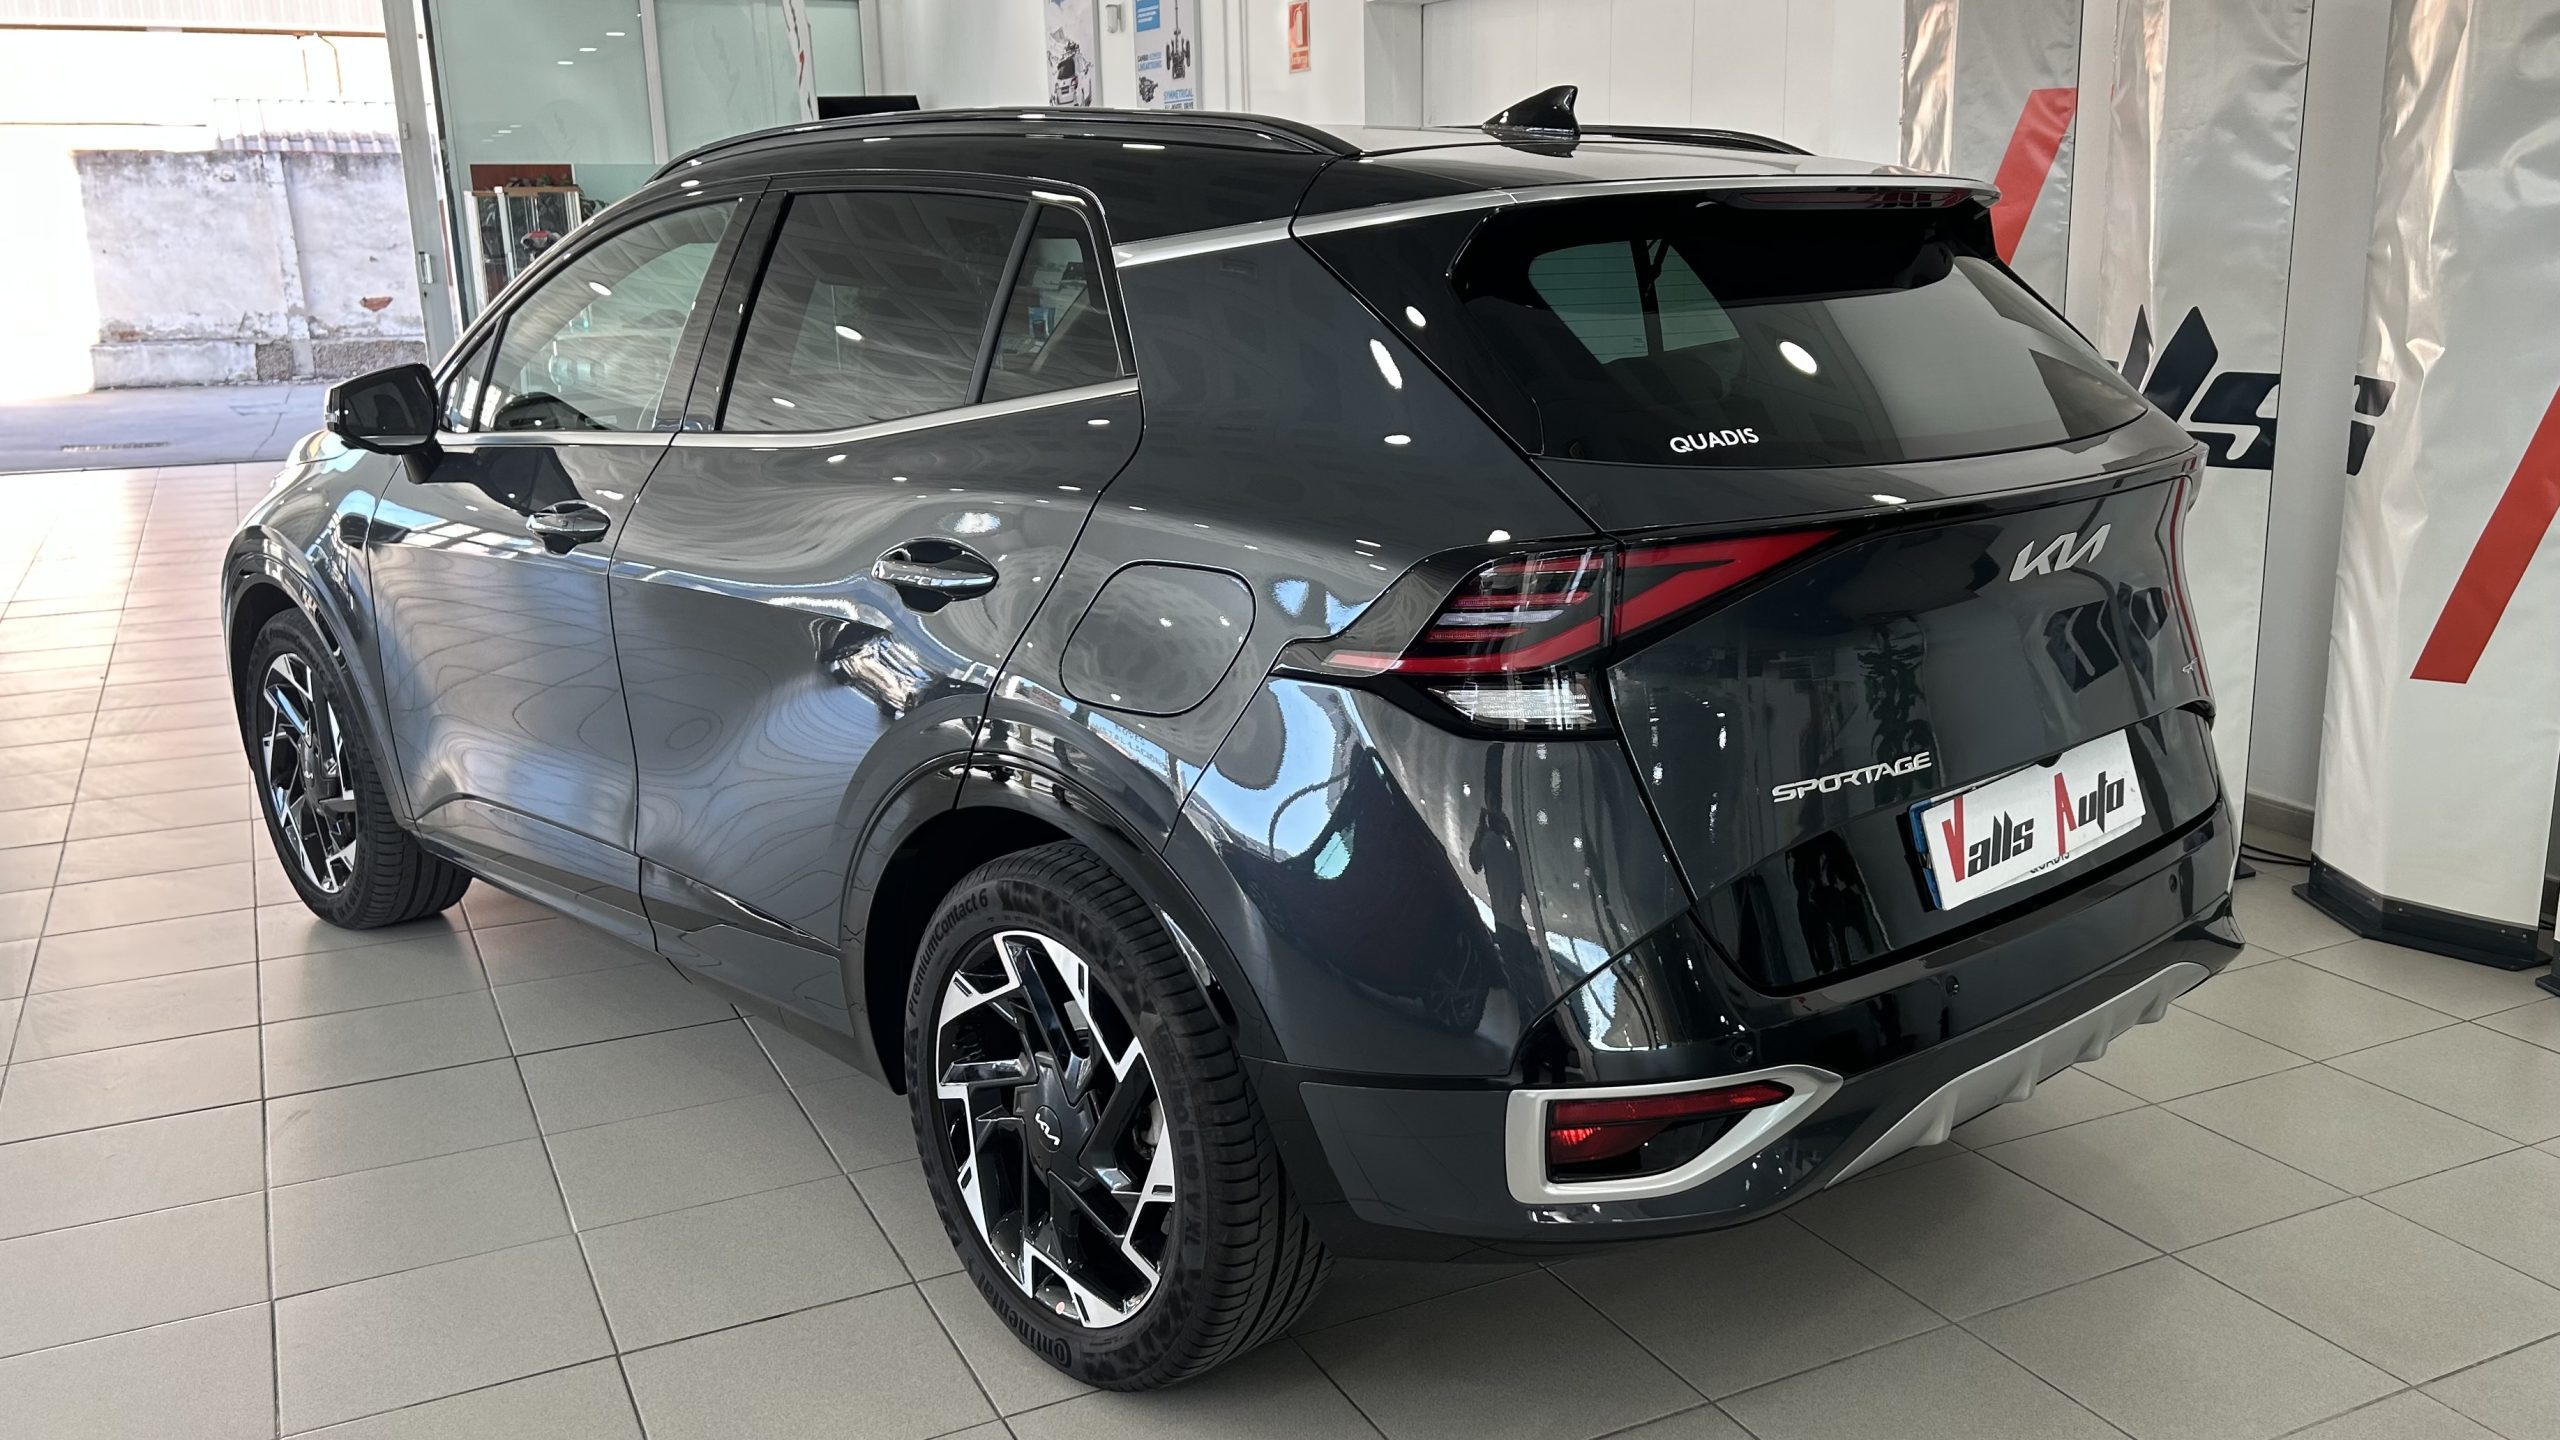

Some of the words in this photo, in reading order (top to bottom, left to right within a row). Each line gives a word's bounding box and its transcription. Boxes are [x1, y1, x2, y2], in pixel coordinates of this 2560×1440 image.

[1669, 427, 1760, 453] QUADIS
[2008, 523, 2112, 582] KIA
[1771, 751, 1933, 803] SPORTAGE
[1941, 795, 2035, 883] Valls
[2054, 770, 2126, 858] Auto
[907, 892, 979, 1018] PremiumContact
[978, 887, 989, 908] 6
[976, 1272, 1073, 1370] Continental
